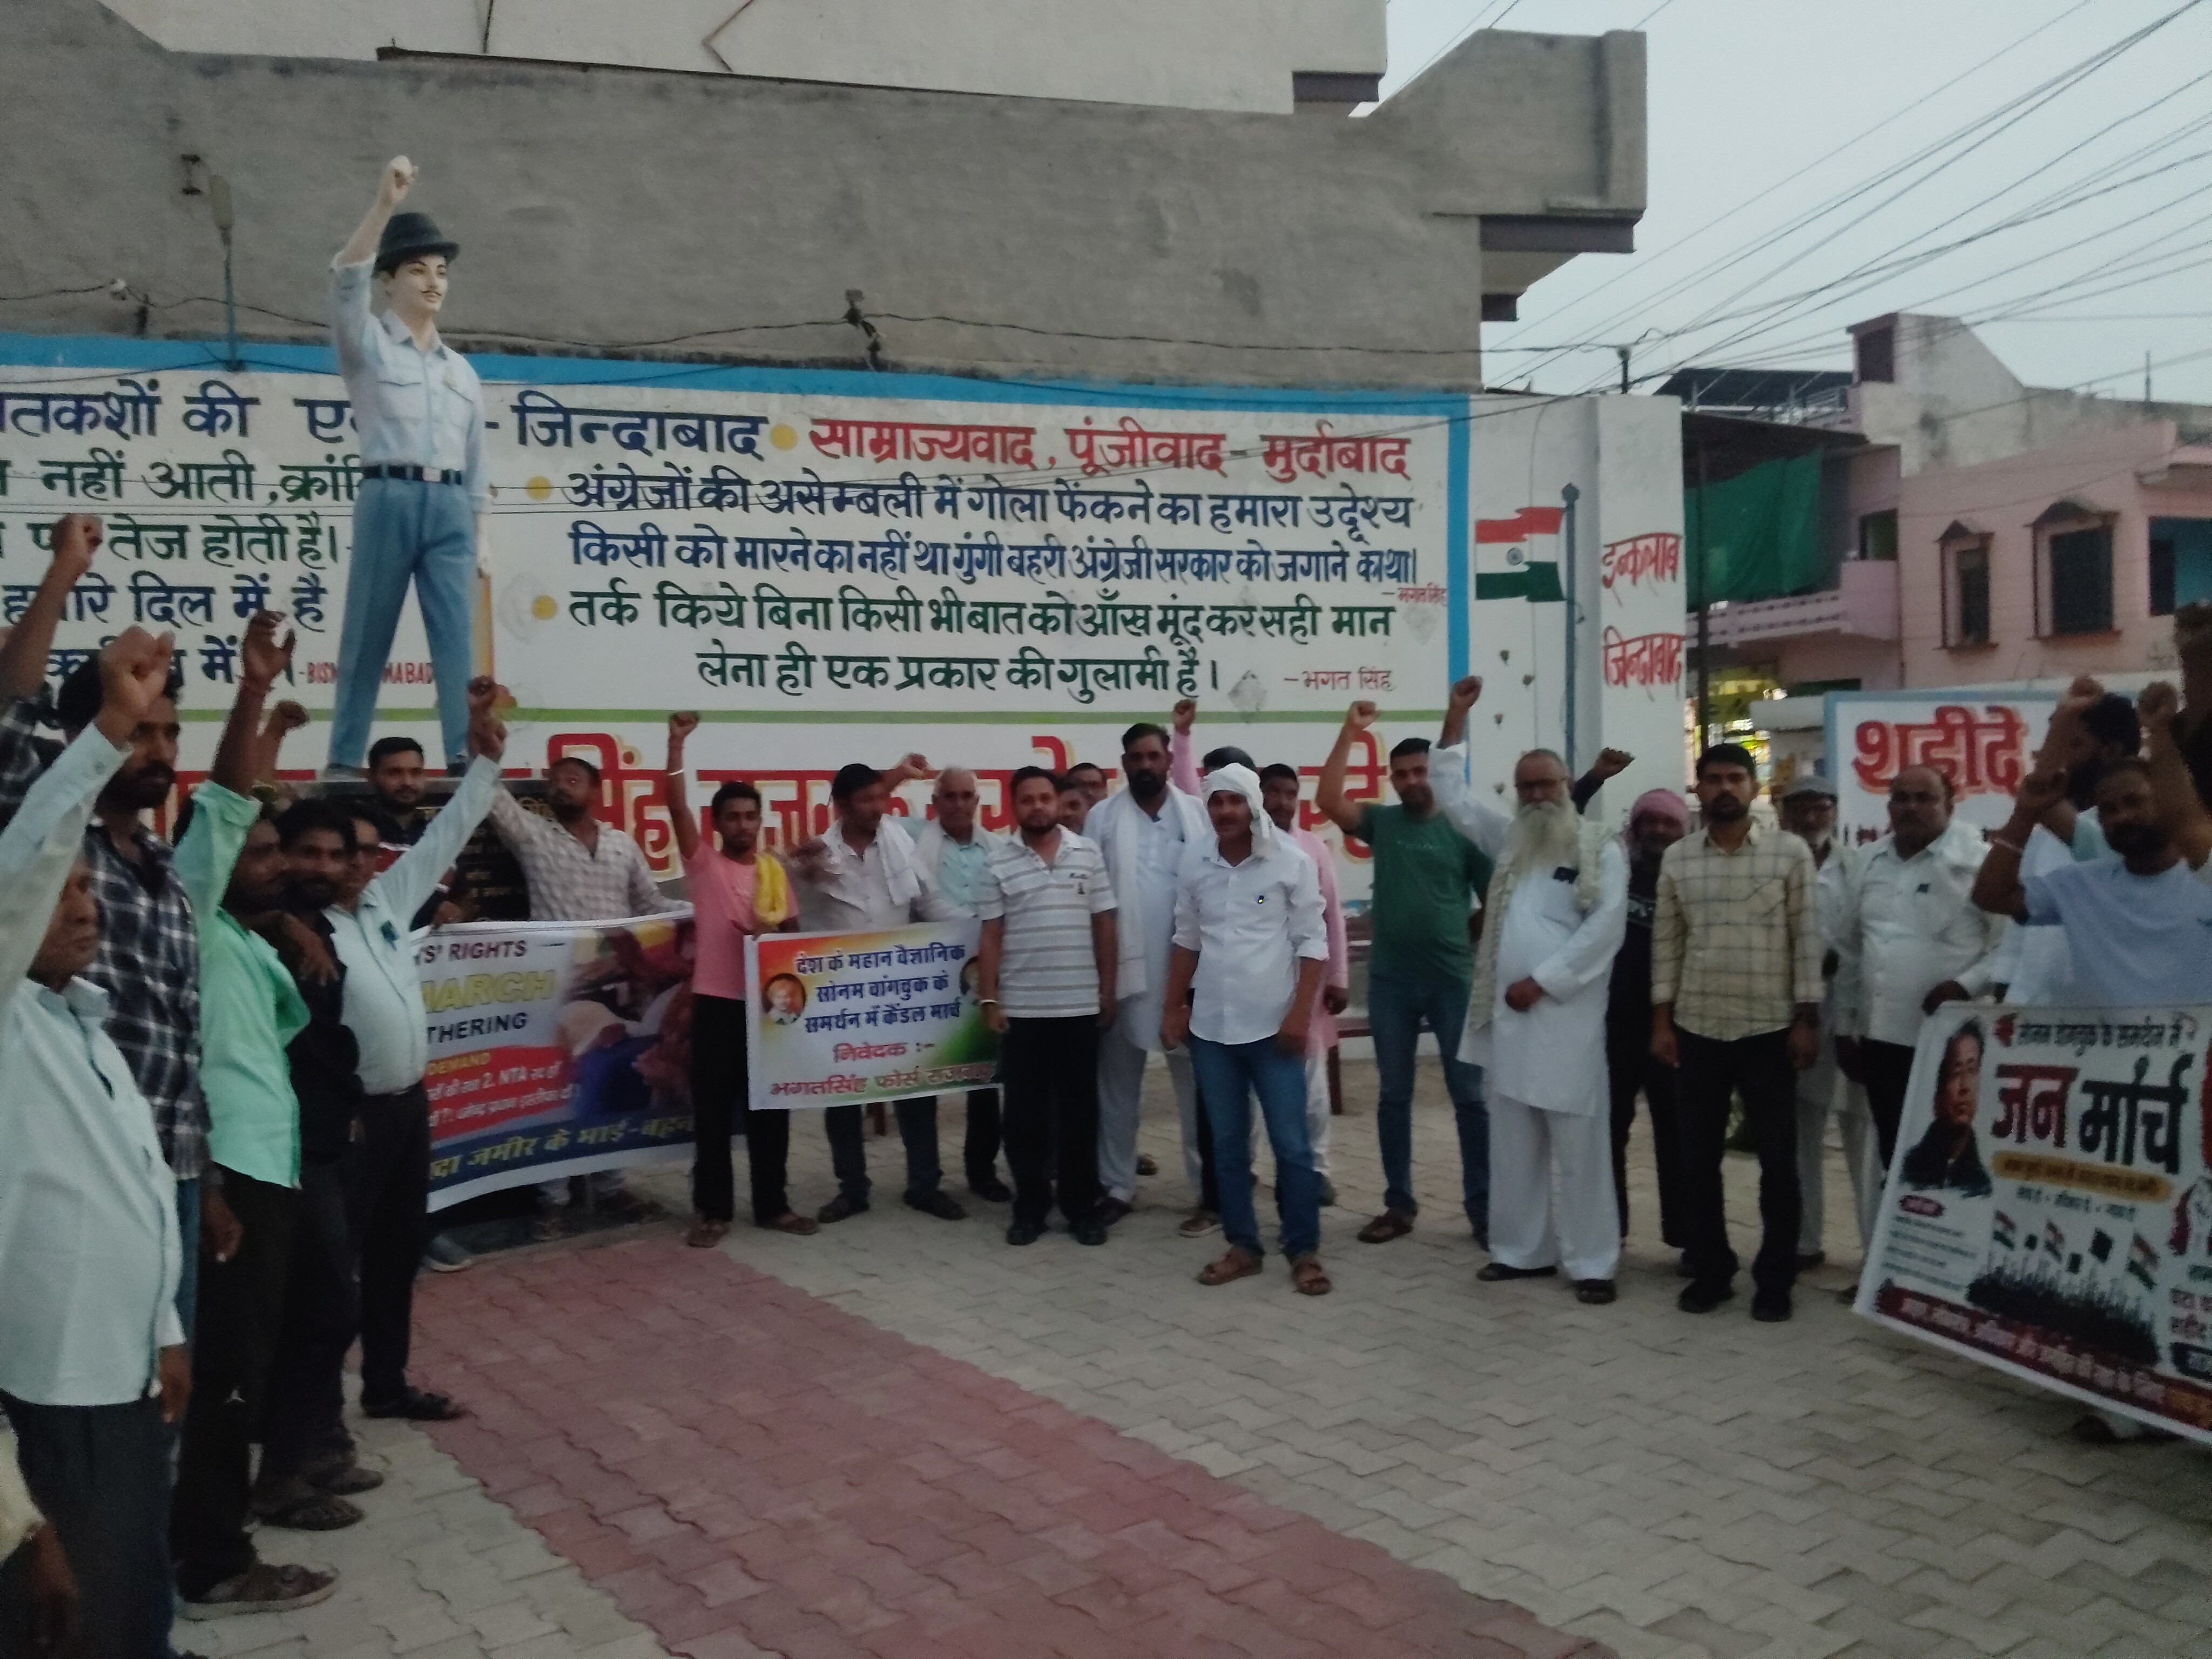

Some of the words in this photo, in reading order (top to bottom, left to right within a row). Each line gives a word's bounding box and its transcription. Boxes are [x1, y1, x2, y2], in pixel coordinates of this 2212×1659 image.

[0, 378, 163, 440] तकशों
[183, 380, 260, 437] की
[510, 390, 769, 461] जिन्दाबाद
[39, 447, 125, 501] नहीं
[1064, 416, 1228, 478] पूंजीवाद
[563, 461, 694, 511] अंग्रेजों
[697, 464, 755, 514] की
[756, 468, 926, 519] असेम्बली
[935, 474, 965, 519] में
[968, 474, 1049, 522] गोला
[1053, 477, 1154, 524] फेंकने
[1156, 493, 1202, 526] का
[1208, 494, 1303, 534] हमारा
[107, 514, 189, 562] तेज
[201, 515, 288, 567] होती
[568, 520, 668, 568] किसी
[675, 524, 727, 570] को
[734, 527, 811, 573] मारने
[814, 539, 853, 574] का
[857, 529, 911, 580] नहीं
[913, 540, 950, 576] था
[1006, 533, 1067, 585] बहरी
[1068, 535, 1152, 582] अंग्रेजी
[1155, 549, 1233, 584] सरकार
[1236, 539, 1271, 582] को
[1273, 539, 1350, 583] जगाने
[127, 570, 216, 628] दिल
[231, 572, 270, 619] में
[292, 572, 327, 632] है
[569, 577, 642, 627] तर्क
[653, 581, 747, 629] किये
[752, 582, 833, 631] बिना
[839, 584, 923, 633] किसी
[928, 585, 966, 633] भी
[966, 601, 1027, 635] बात
[1027, 590, 1076, 636] को
[1205, 605, 1257, 637] कर
[1258, 593, 1321, 645] सही
[1331, 606, 1397, 637] मान
[696, 638, 769, 687] लेना
[774, 641, 817, 696] ही
[822, 654, 891, 690] एक
[894, 656, 1000, 691] प्रकार
[1006, 646, 1055, 690] की
[1057, 645, 1170, 704] गुलामी
[1303, 670, 1353, 691] भगत
[448, 940, 527, 962] RIGHTS
[848, 951, 893, 969] महान
[427, 1013, 528, 1044] THERING
[1992, 1063, 2081, 1148] जन
